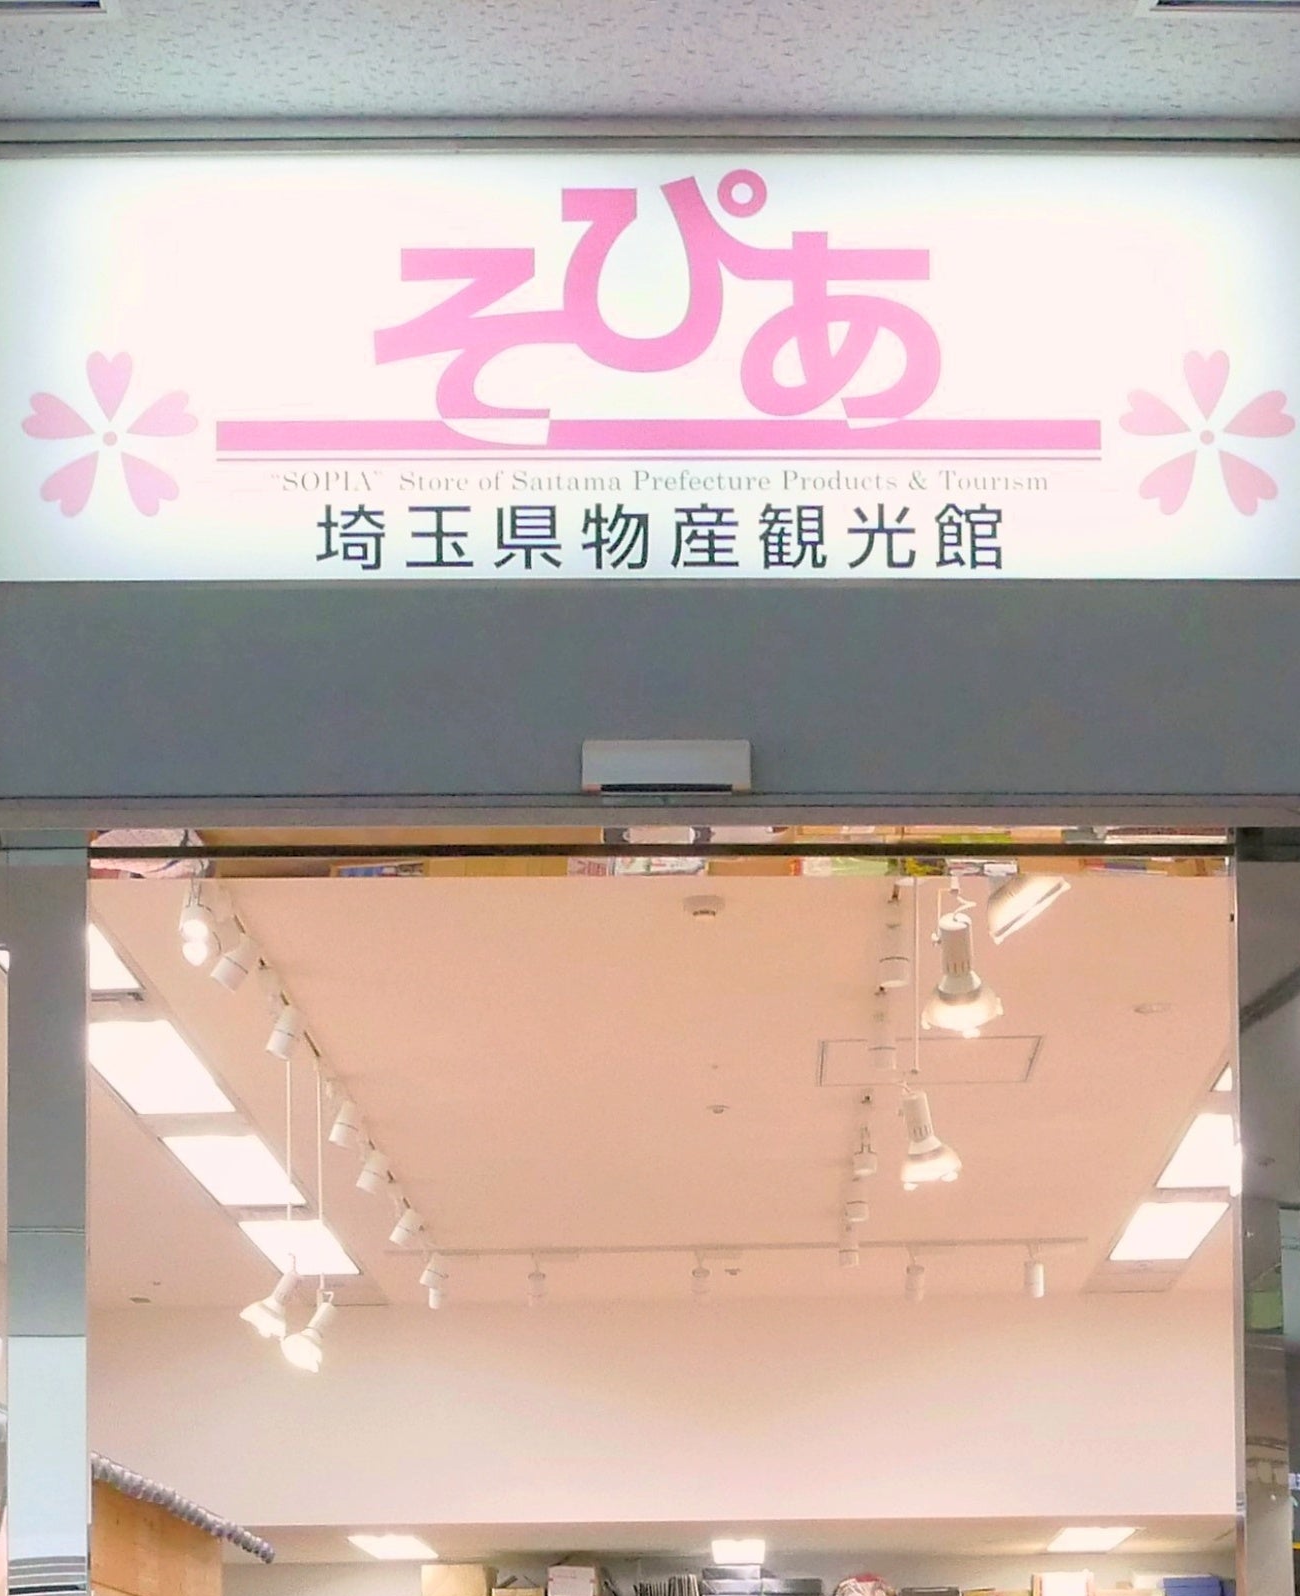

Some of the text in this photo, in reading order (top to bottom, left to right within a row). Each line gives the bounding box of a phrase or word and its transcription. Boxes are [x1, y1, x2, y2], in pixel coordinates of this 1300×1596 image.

[374, 169, 943, 445] そぴあ
[399, 470, 469, 492] Store
[478, 470, 503, 492] of
[511, 470, 622, 492] Saitama
[634, 470, 771, 492] Prefecture
[782, 470, 898, 492] Products
[907, 470, 928, 492] &
[938, 470, 1049, 492] Tourism
[316, 503, 1003, 570] 埼玉県物産観光館
